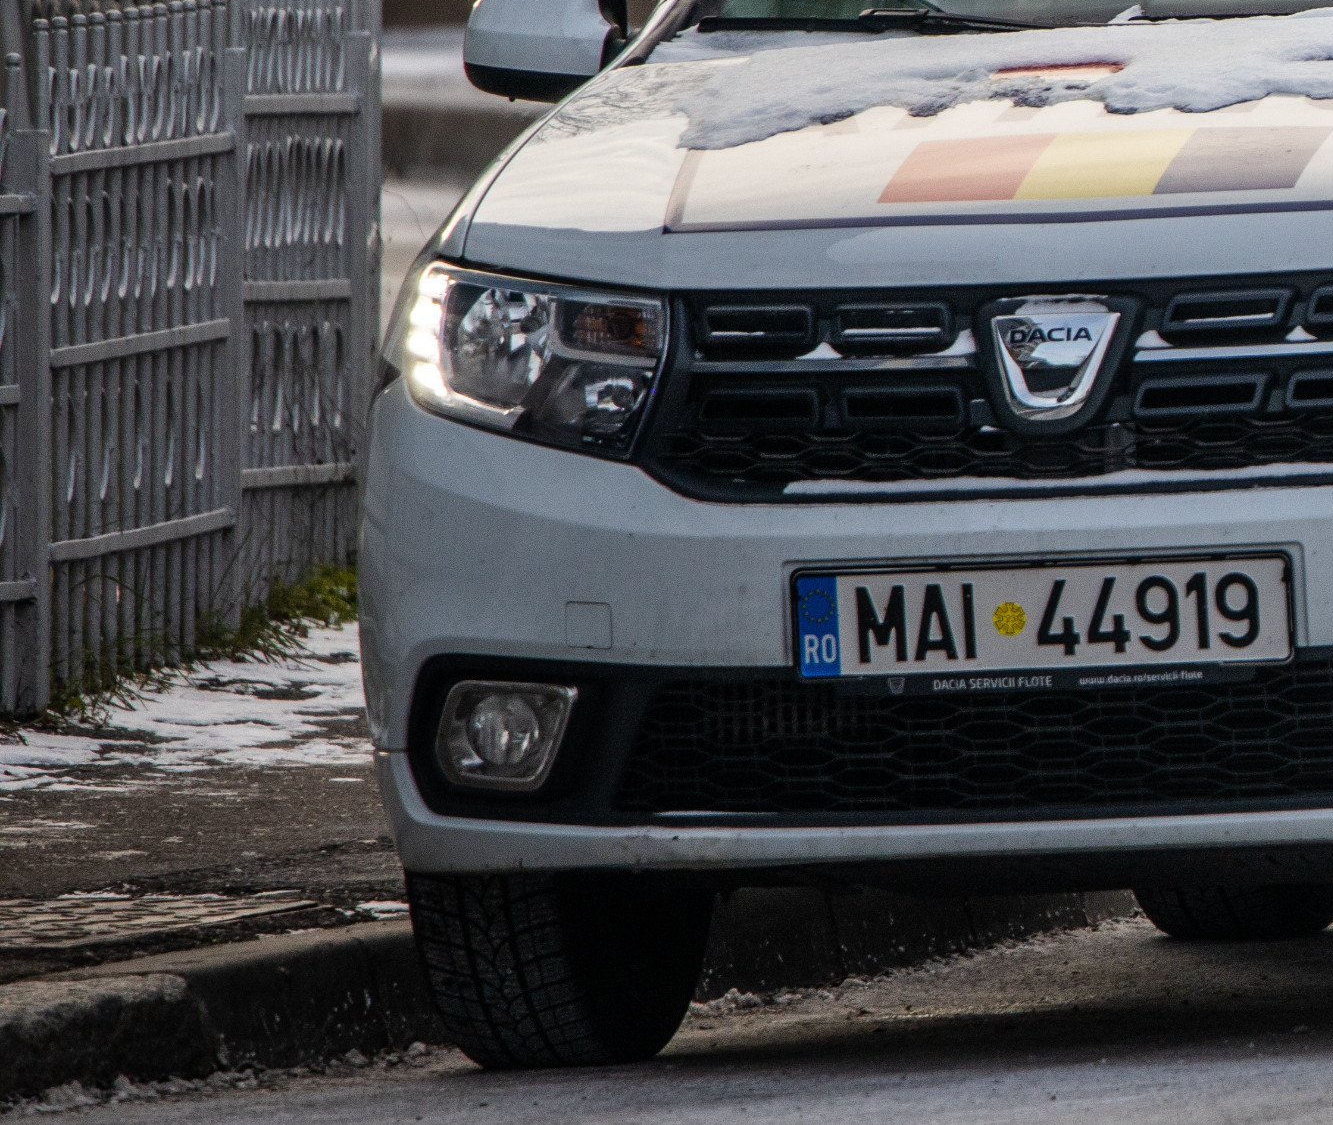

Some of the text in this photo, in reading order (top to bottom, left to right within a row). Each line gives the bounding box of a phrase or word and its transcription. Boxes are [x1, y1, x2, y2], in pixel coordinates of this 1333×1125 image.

[1010, 327, 1092, 343] DACIA
[855, 572, 1261, 664] MAI 44919
[804, 634, 837, 663] RO
[933, 676, 1053, 690] DACIA SERVICII FLOTE
